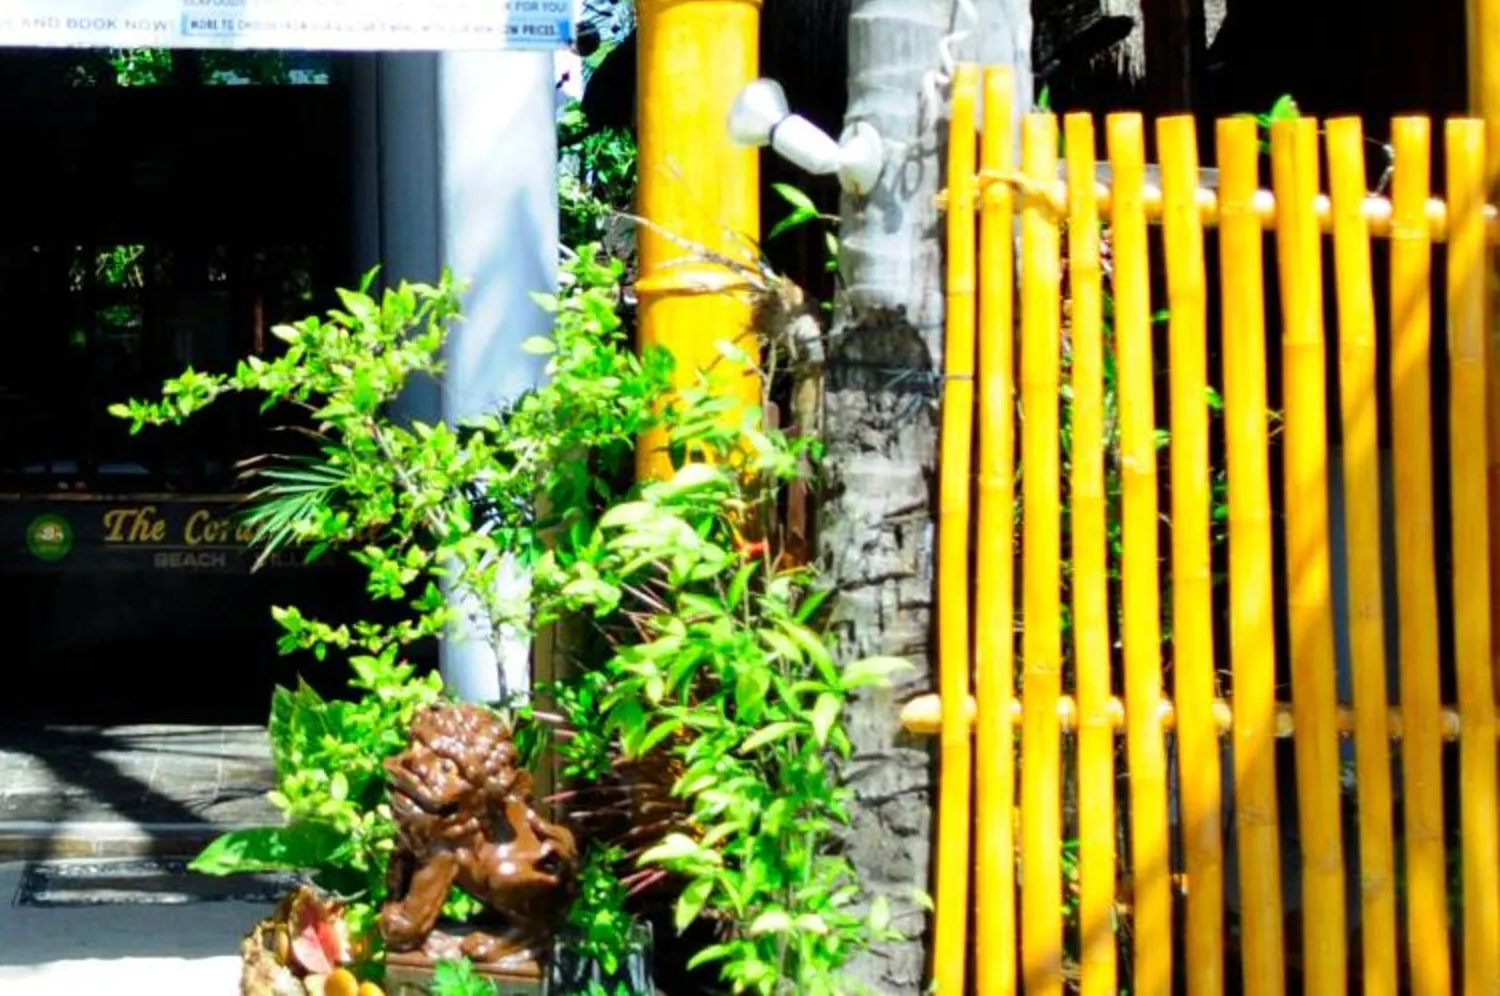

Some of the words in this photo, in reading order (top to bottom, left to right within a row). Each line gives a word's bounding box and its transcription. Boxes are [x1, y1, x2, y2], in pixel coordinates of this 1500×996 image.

[515, 2, 539, 11] FOR
[22, 18, 60, 29] AND
[66, 18, 120, 30] BOOK
[124, 19, 167, 32] NOW
[103, 506, 166, 542] The
[184, 509, 273, 546] Cora
[153, 553, 226, 569] BEACH
